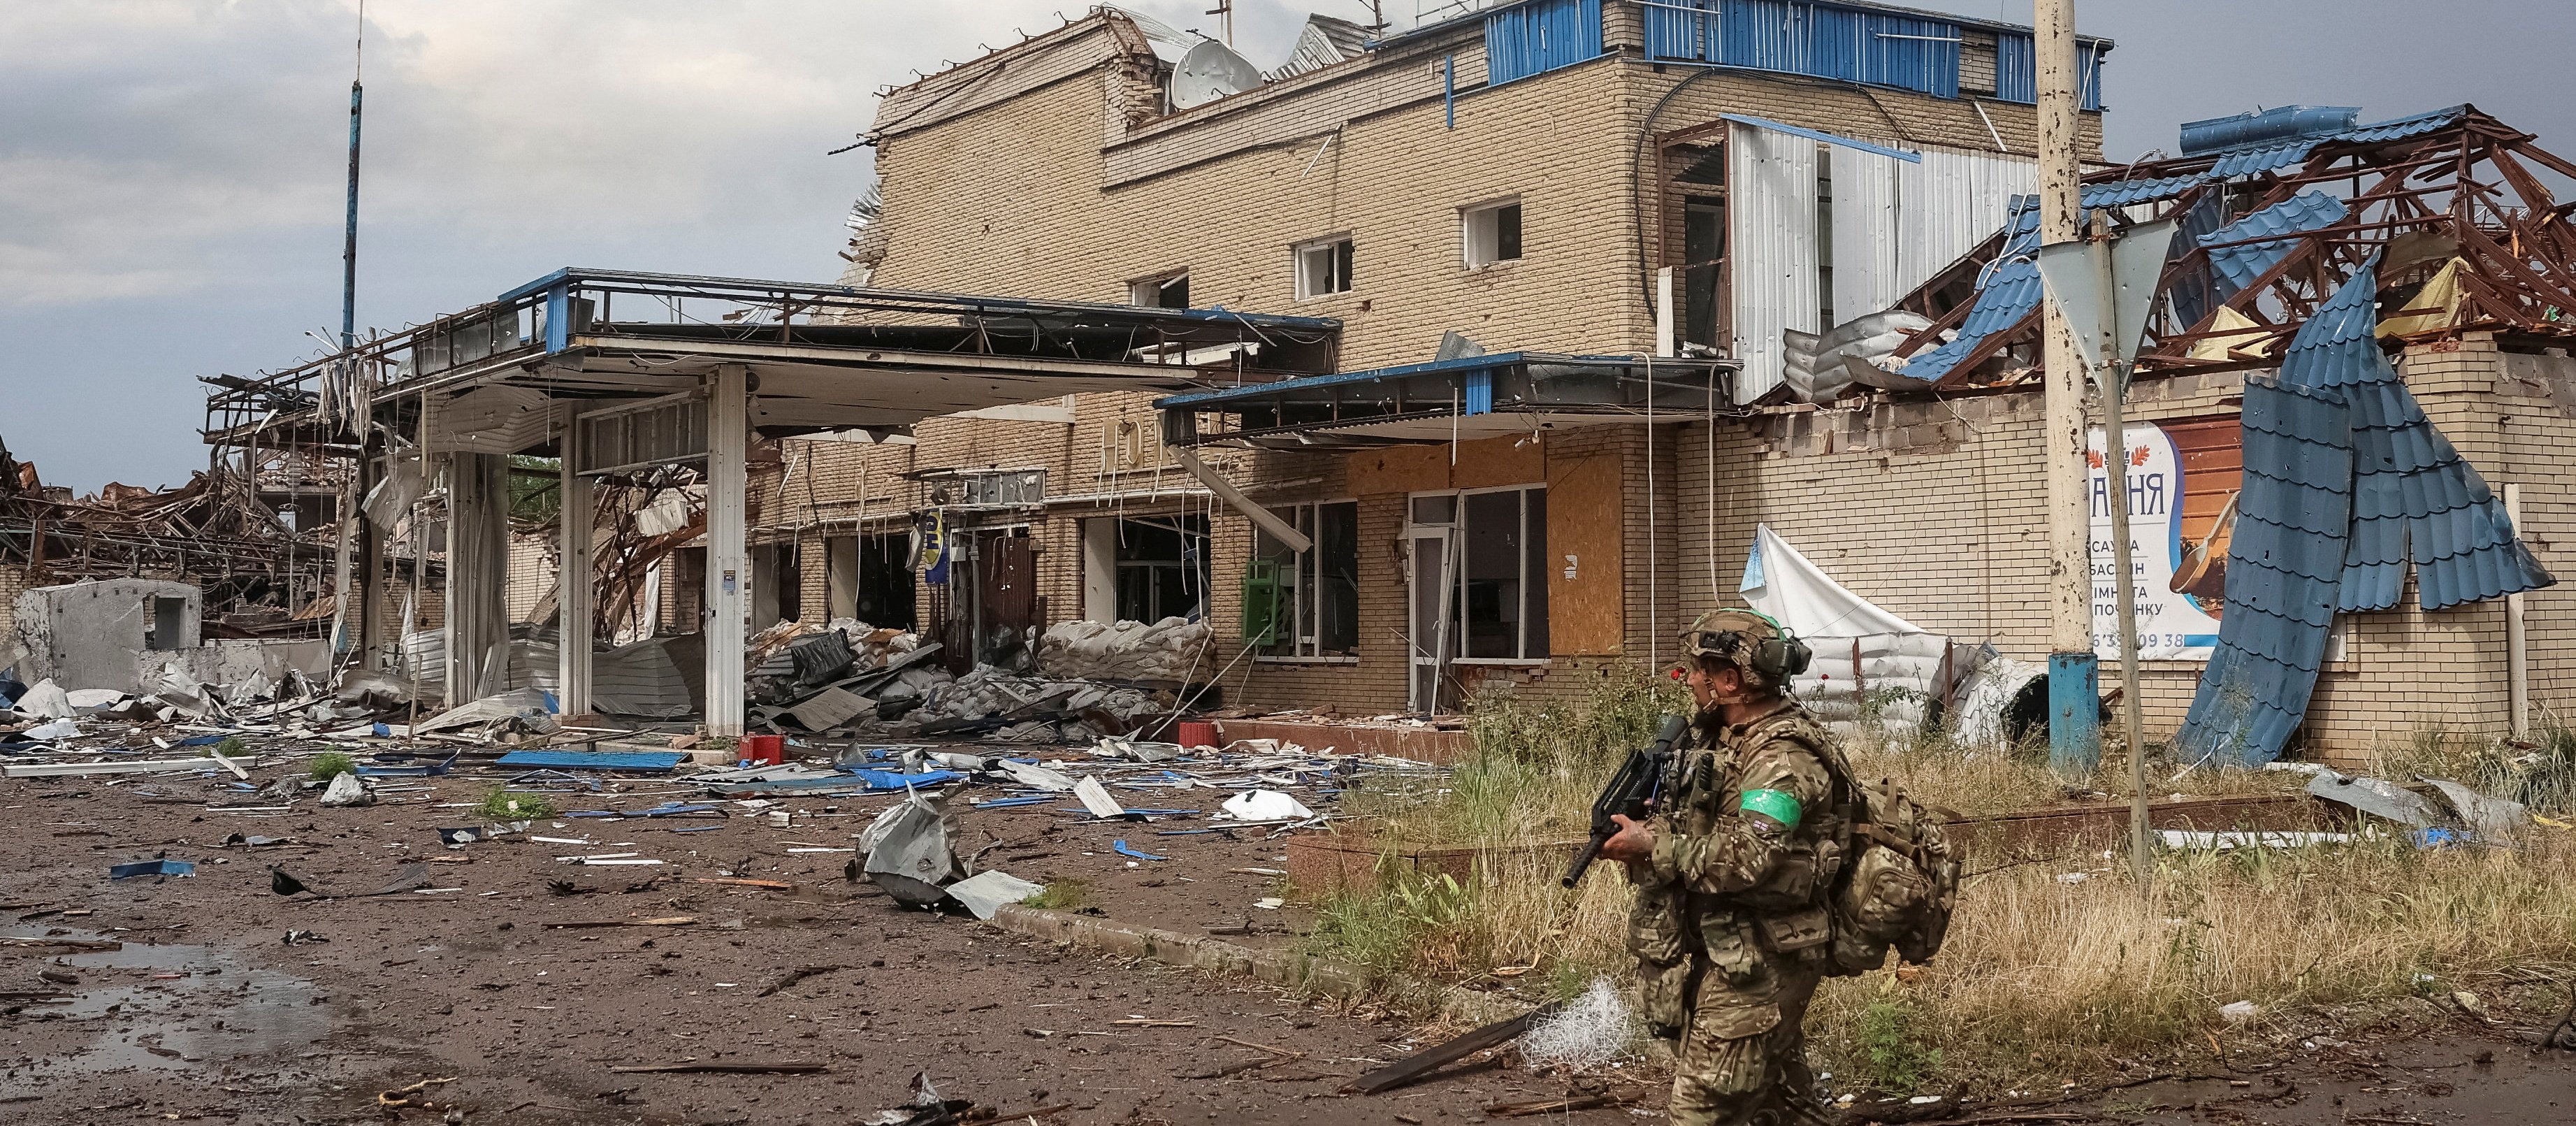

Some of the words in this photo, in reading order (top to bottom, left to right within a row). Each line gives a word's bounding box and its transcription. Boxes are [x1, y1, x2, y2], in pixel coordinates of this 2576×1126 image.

[2092, 473, 2164, 517] АНЯ
[2092, 540, 2140, 553] САА
[2090, 563, 2144, 576] БАСН
[2092, 586, 2148, 598] ІМНТА
[2164, 634, 2184, 647] 38
